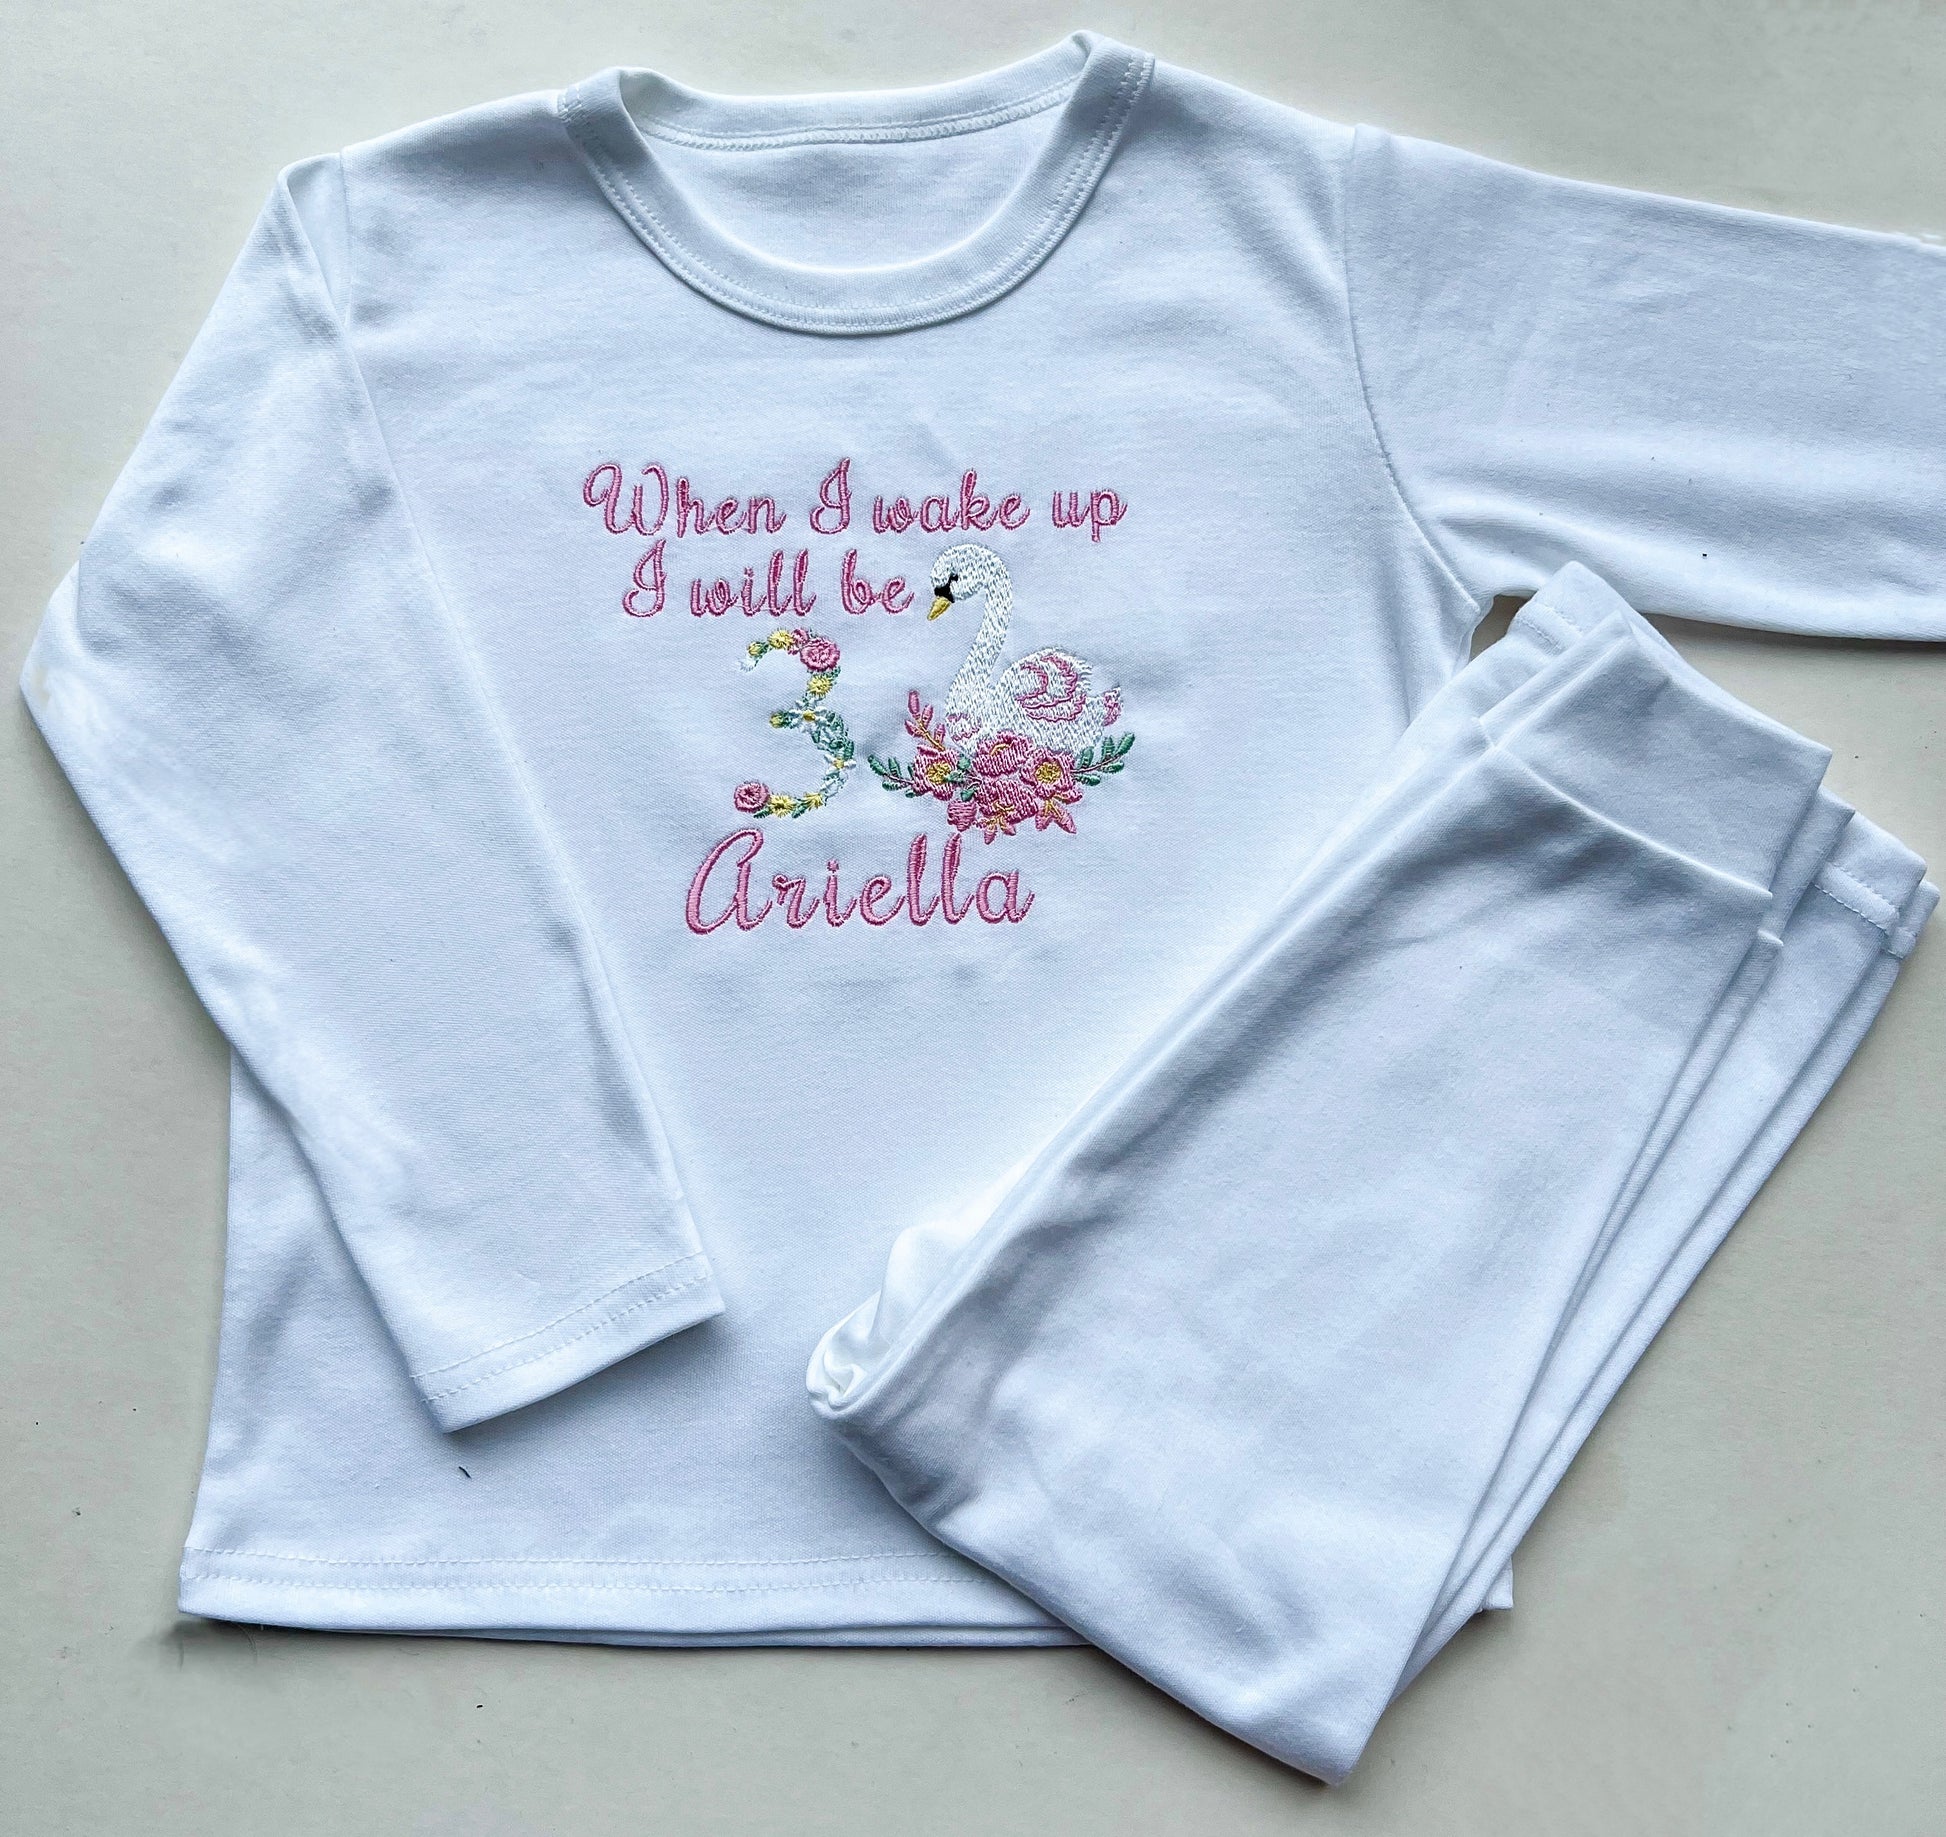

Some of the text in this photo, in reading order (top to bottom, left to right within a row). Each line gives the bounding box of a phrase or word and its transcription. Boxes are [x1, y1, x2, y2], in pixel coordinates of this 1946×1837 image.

[583, 458, 1127, 542] When I wake up
[622, 540, 915, 617] I will be
[733, 627, 856, 819] 3
[684, 828, 1035, 935] Ariella
